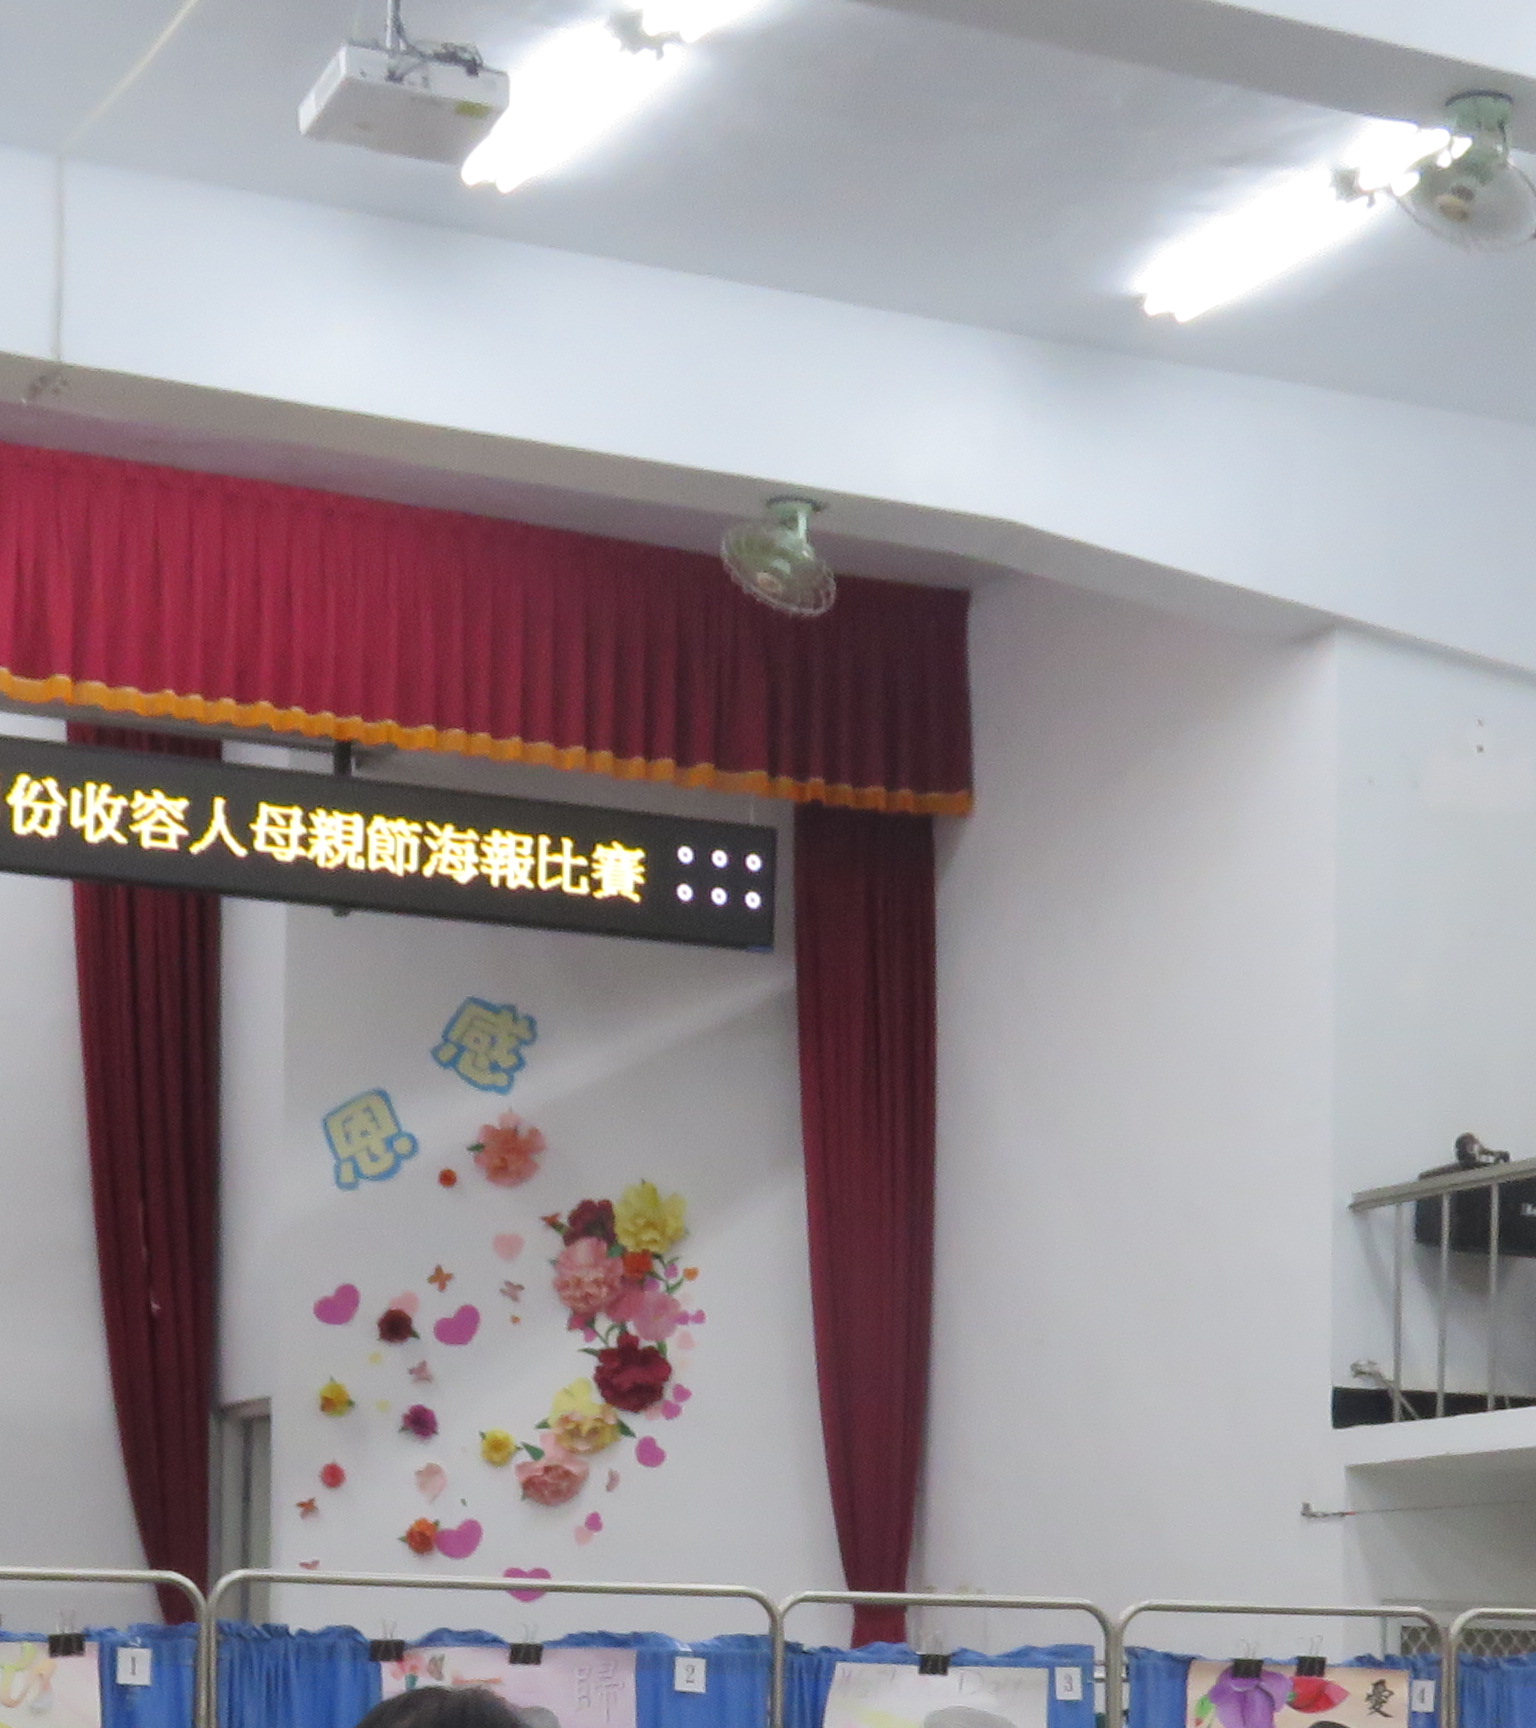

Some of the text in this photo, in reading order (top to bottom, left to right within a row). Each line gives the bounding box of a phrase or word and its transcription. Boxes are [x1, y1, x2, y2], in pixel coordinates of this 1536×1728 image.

[685, 1664, 696, 1684] 2
[1063, 1674, 1074, 1692] 3
[1366, 1679, 1404, 1718] 愛
